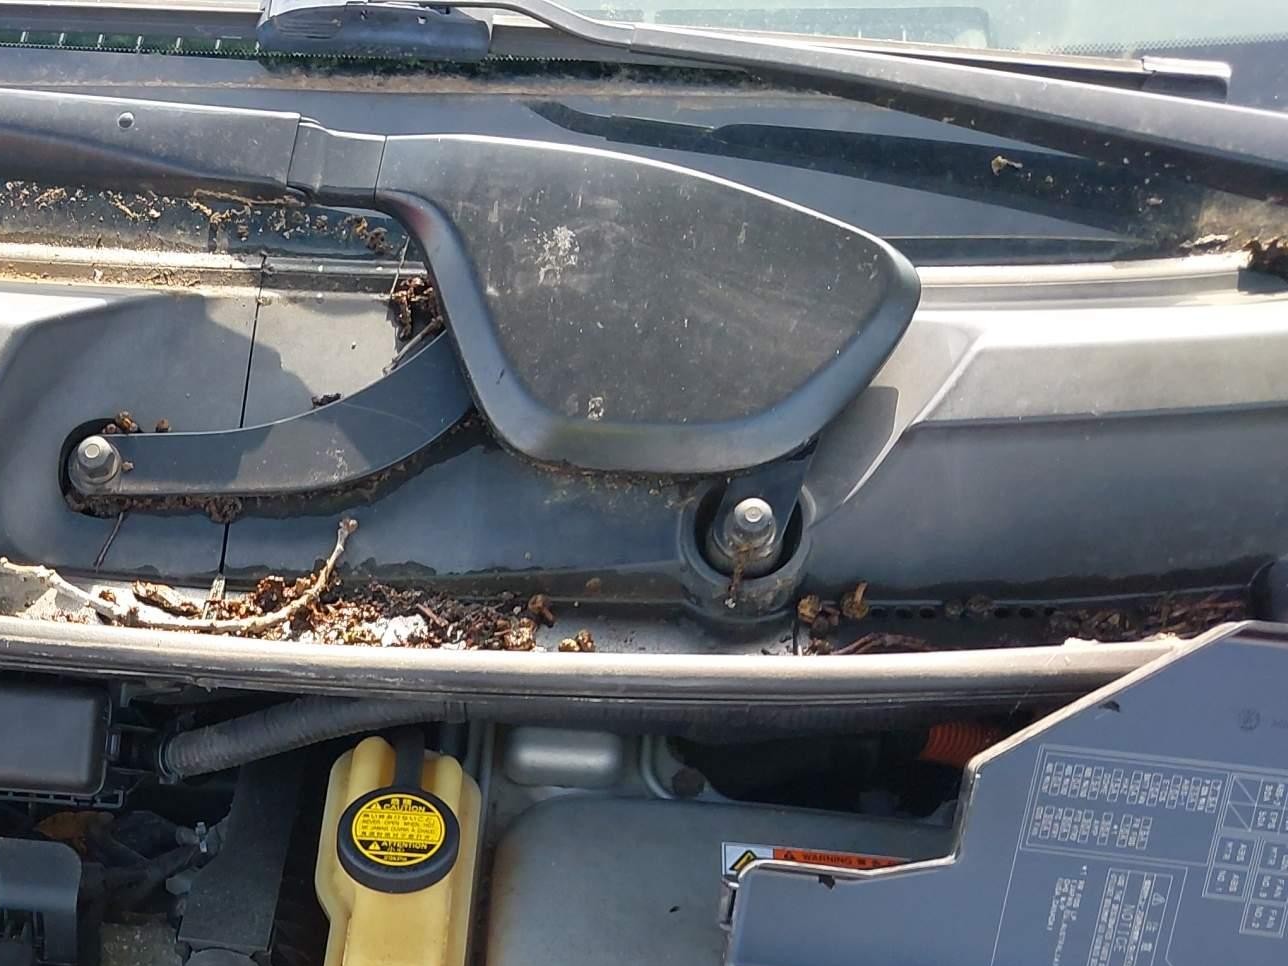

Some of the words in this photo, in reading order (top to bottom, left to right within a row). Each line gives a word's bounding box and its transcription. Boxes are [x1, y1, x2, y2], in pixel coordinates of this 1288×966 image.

[383, 803, 426, 813] CAUTION
[381, 840, 428, 851] ATTENTION
[802, 854, 853, 866] WARNING
[1112, 903, 1135, 953] NOTICE
